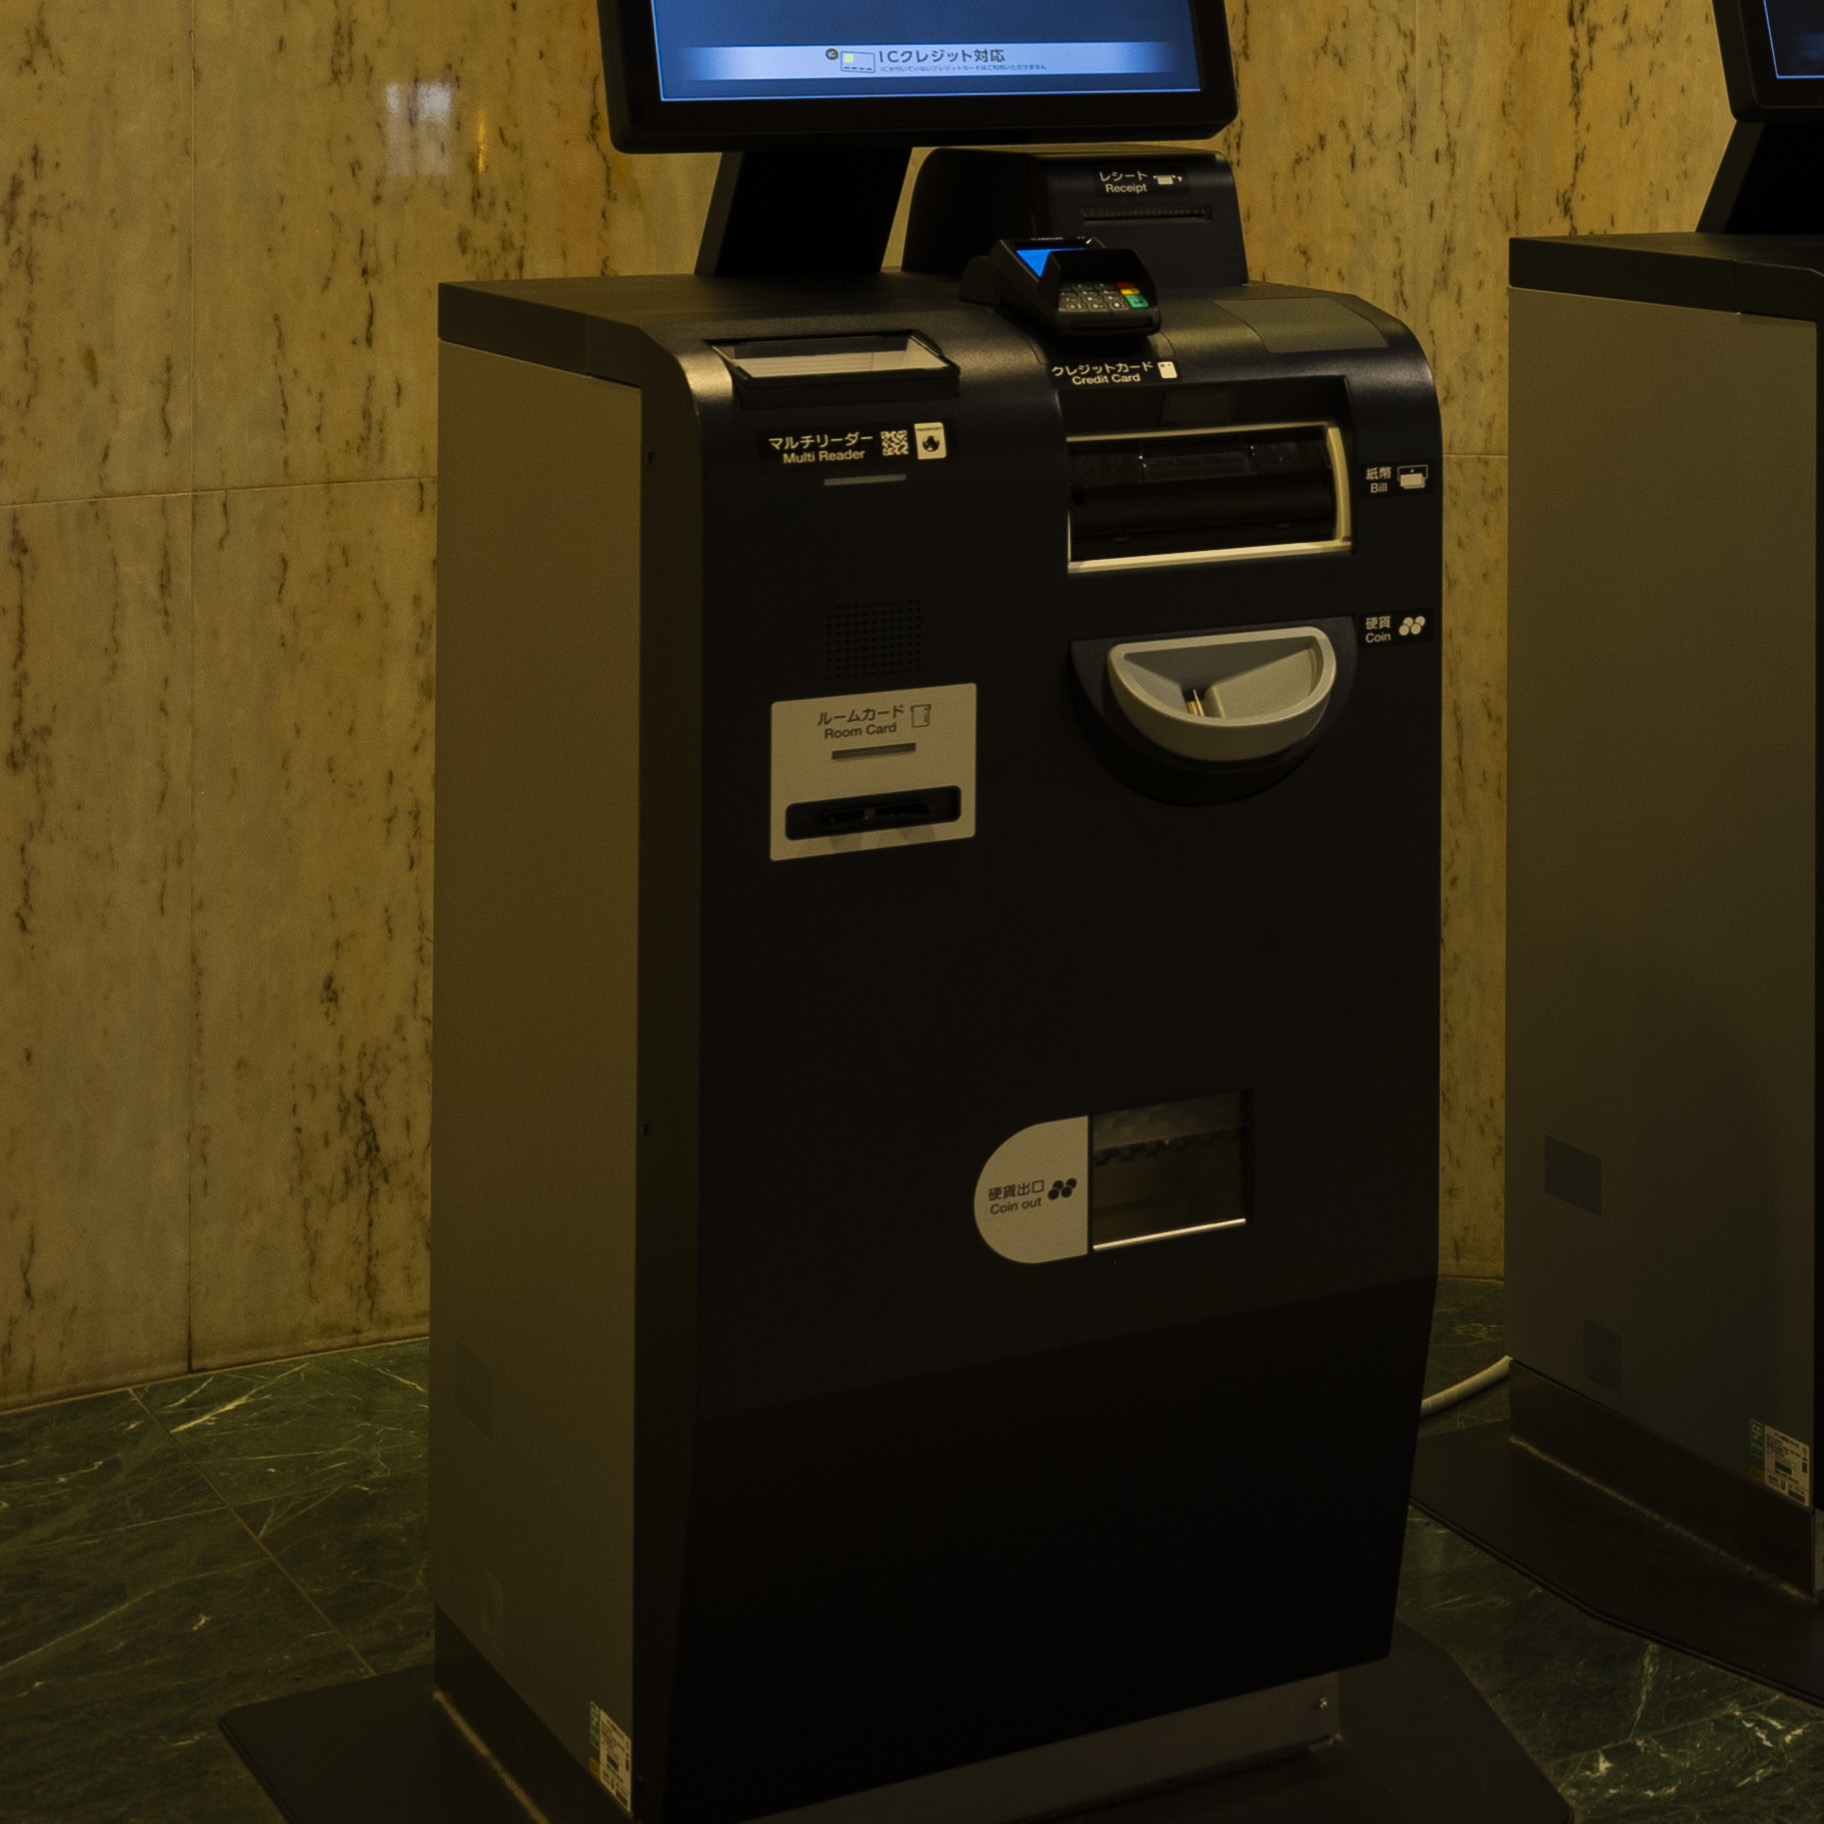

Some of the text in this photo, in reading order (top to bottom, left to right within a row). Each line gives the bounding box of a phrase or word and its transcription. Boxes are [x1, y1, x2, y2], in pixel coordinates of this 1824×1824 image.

[878, 49, 1005, 64] ICクレジット対応
[1099, 171, 1148, 182] レシート
[1105, 183, 1147, 194] Receipt
[1051, 361, 1153, 376] クレジットカード
[1072, 373, 1141, 385] Credit Card
[768, 431, 874, 450] マルチリーダー
[783, 449, 865, 464] Multi Reader
[1370, 482, 1387, 494] Bill
[1365, 631, 1392, 644] Coin
[817, 704, 905, 727] ルームカード
[824, 722, 897, 740] Room Card
[988, 1179, 1045, 1201] 硬貨出口
[990, 1197, 1042, 1215] Coin out
